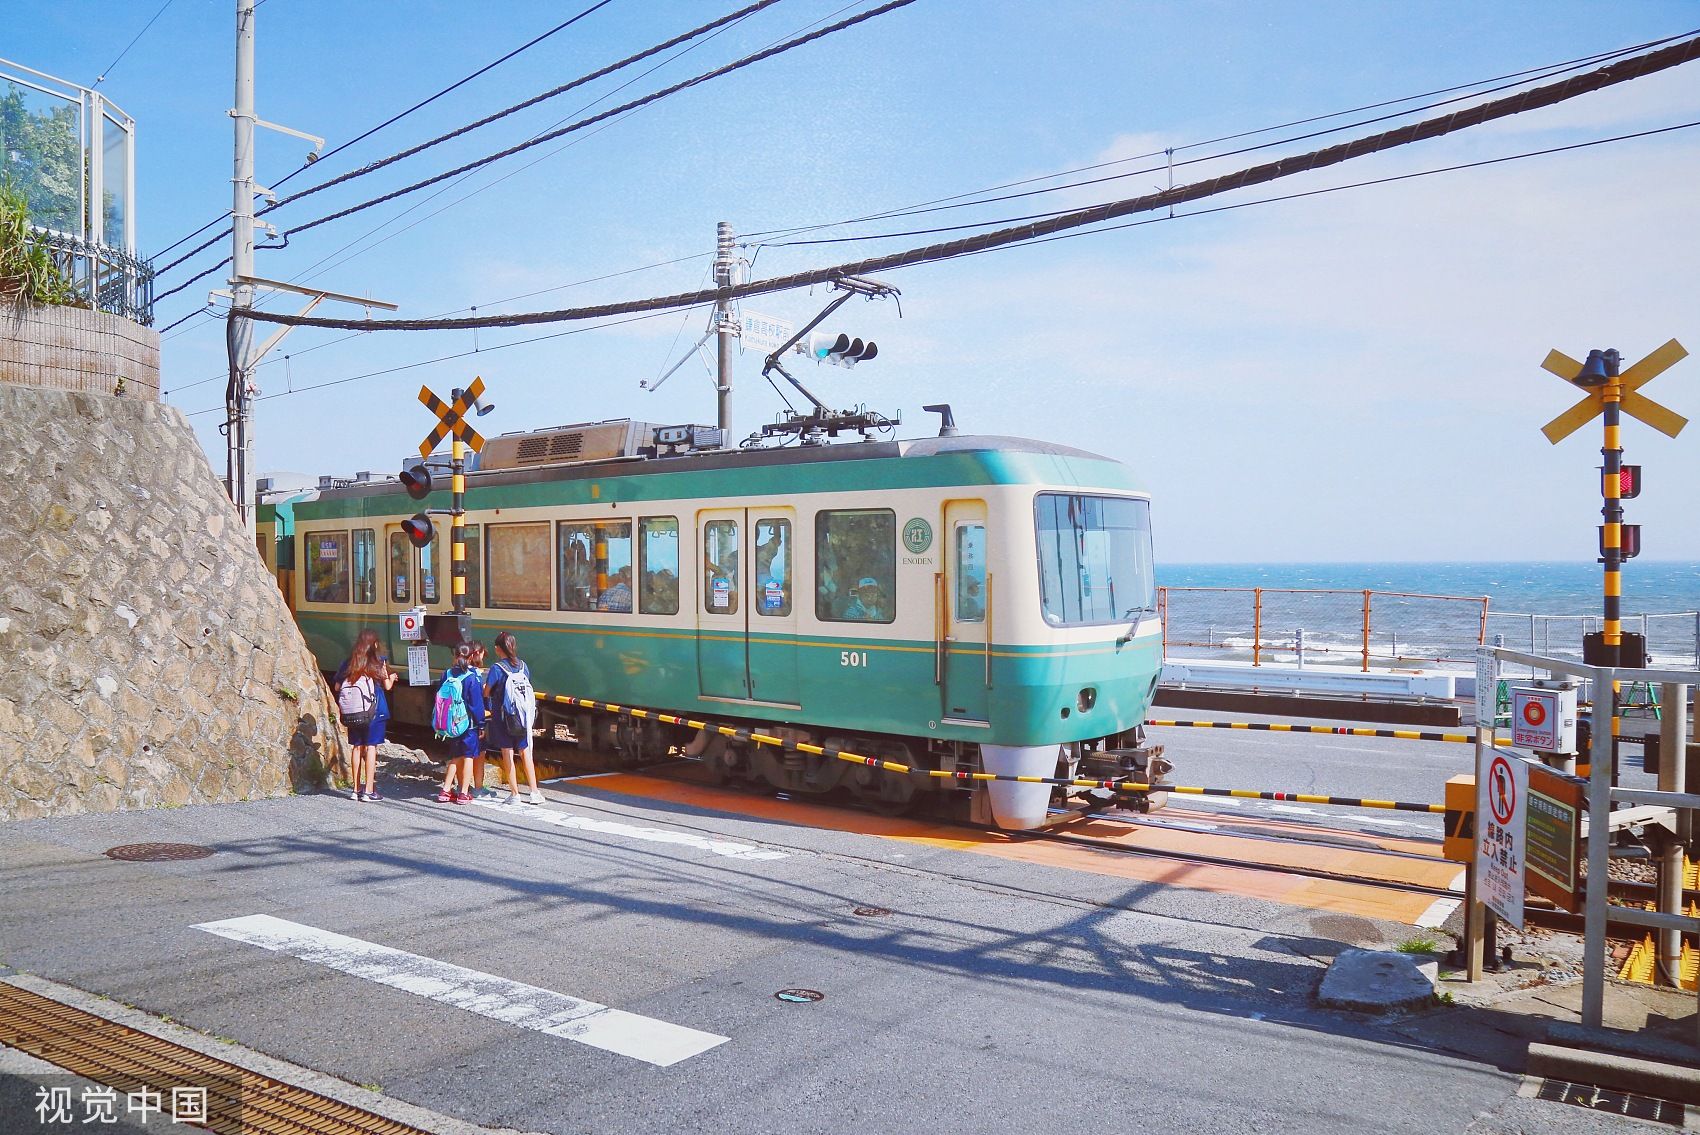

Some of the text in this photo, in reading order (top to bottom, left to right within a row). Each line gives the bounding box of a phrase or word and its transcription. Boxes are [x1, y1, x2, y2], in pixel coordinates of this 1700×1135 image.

[840, 651, 867, 667] 501
[1516, 733, 1553, 746] 非常ボタン
[1487, 820, 1513, 852] 線路内
[1482, 837, 1518, 875] 立入禁止
